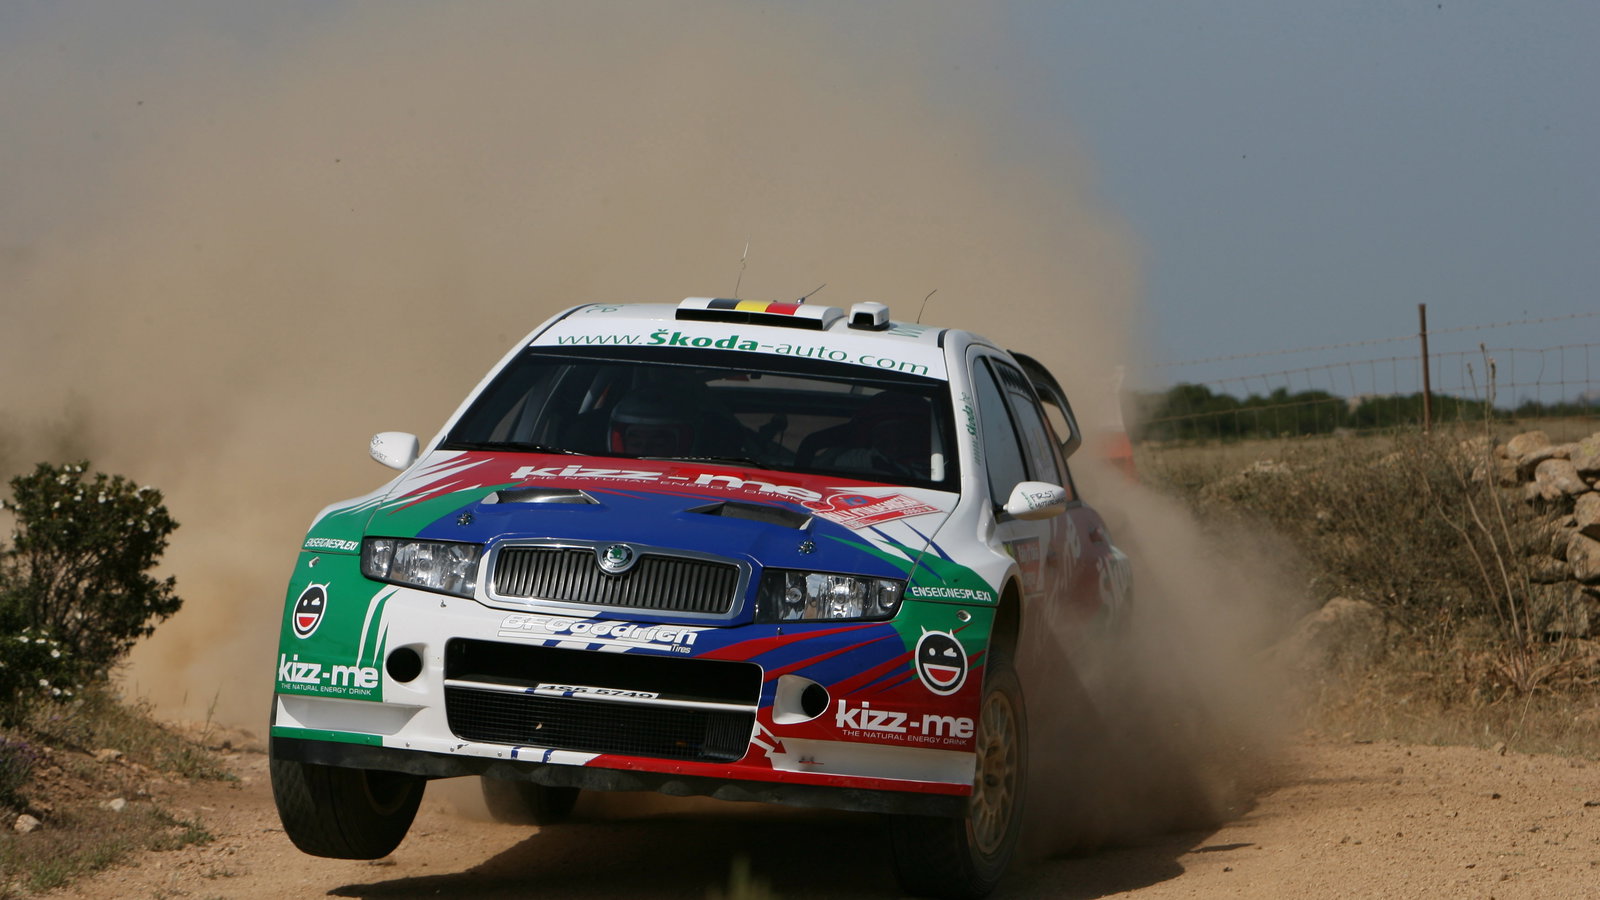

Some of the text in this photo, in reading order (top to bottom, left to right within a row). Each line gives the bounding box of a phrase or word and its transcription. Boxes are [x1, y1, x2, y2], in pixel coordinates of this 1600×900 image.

[557, 328, 929, 376] www.Škoda-auto.com
[510, 464, 822, 502] kizz-me
[305, 538, 359, 550] ENSEIGNESPLEXI
[912, 587, 992, 601] ENSEIGNESPLEXI
[500, 614, 698, 645] BFGoodrich
[670, 644, 692, 654] Tires
[279, 653, 379, 689] kizz-me
[292, 684, 319, 692] NATURAL
[349, 688, 372, 696] DRINK
[835, 699, 974, 739] kizz-me
[863, 732, 905, 741] NATURAL
[907, 735, 941, 744] ENERGY
